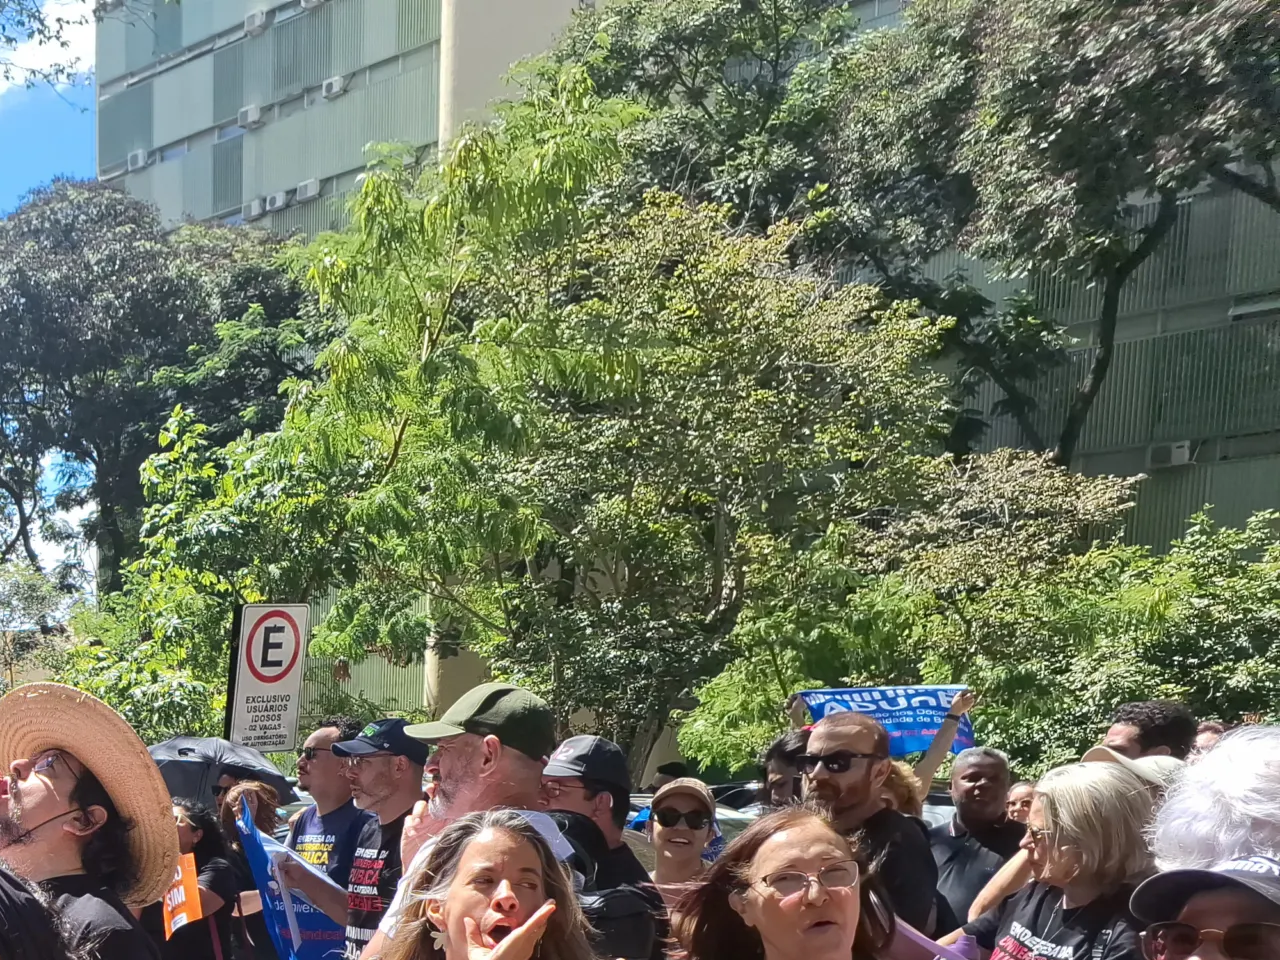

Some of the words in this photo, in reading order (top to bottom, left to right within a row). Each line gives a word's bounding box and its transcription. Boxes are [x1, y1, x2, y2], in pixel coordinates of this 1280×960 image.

[260, 625, 286, 668] E
[245, 694, 291, 704] EXCLUSIVO
[246, 703, 288, 713] USUÁRIOS
[251, 714, 282, 723] IDOSOS
[166, 885, 186, 912] SIM
